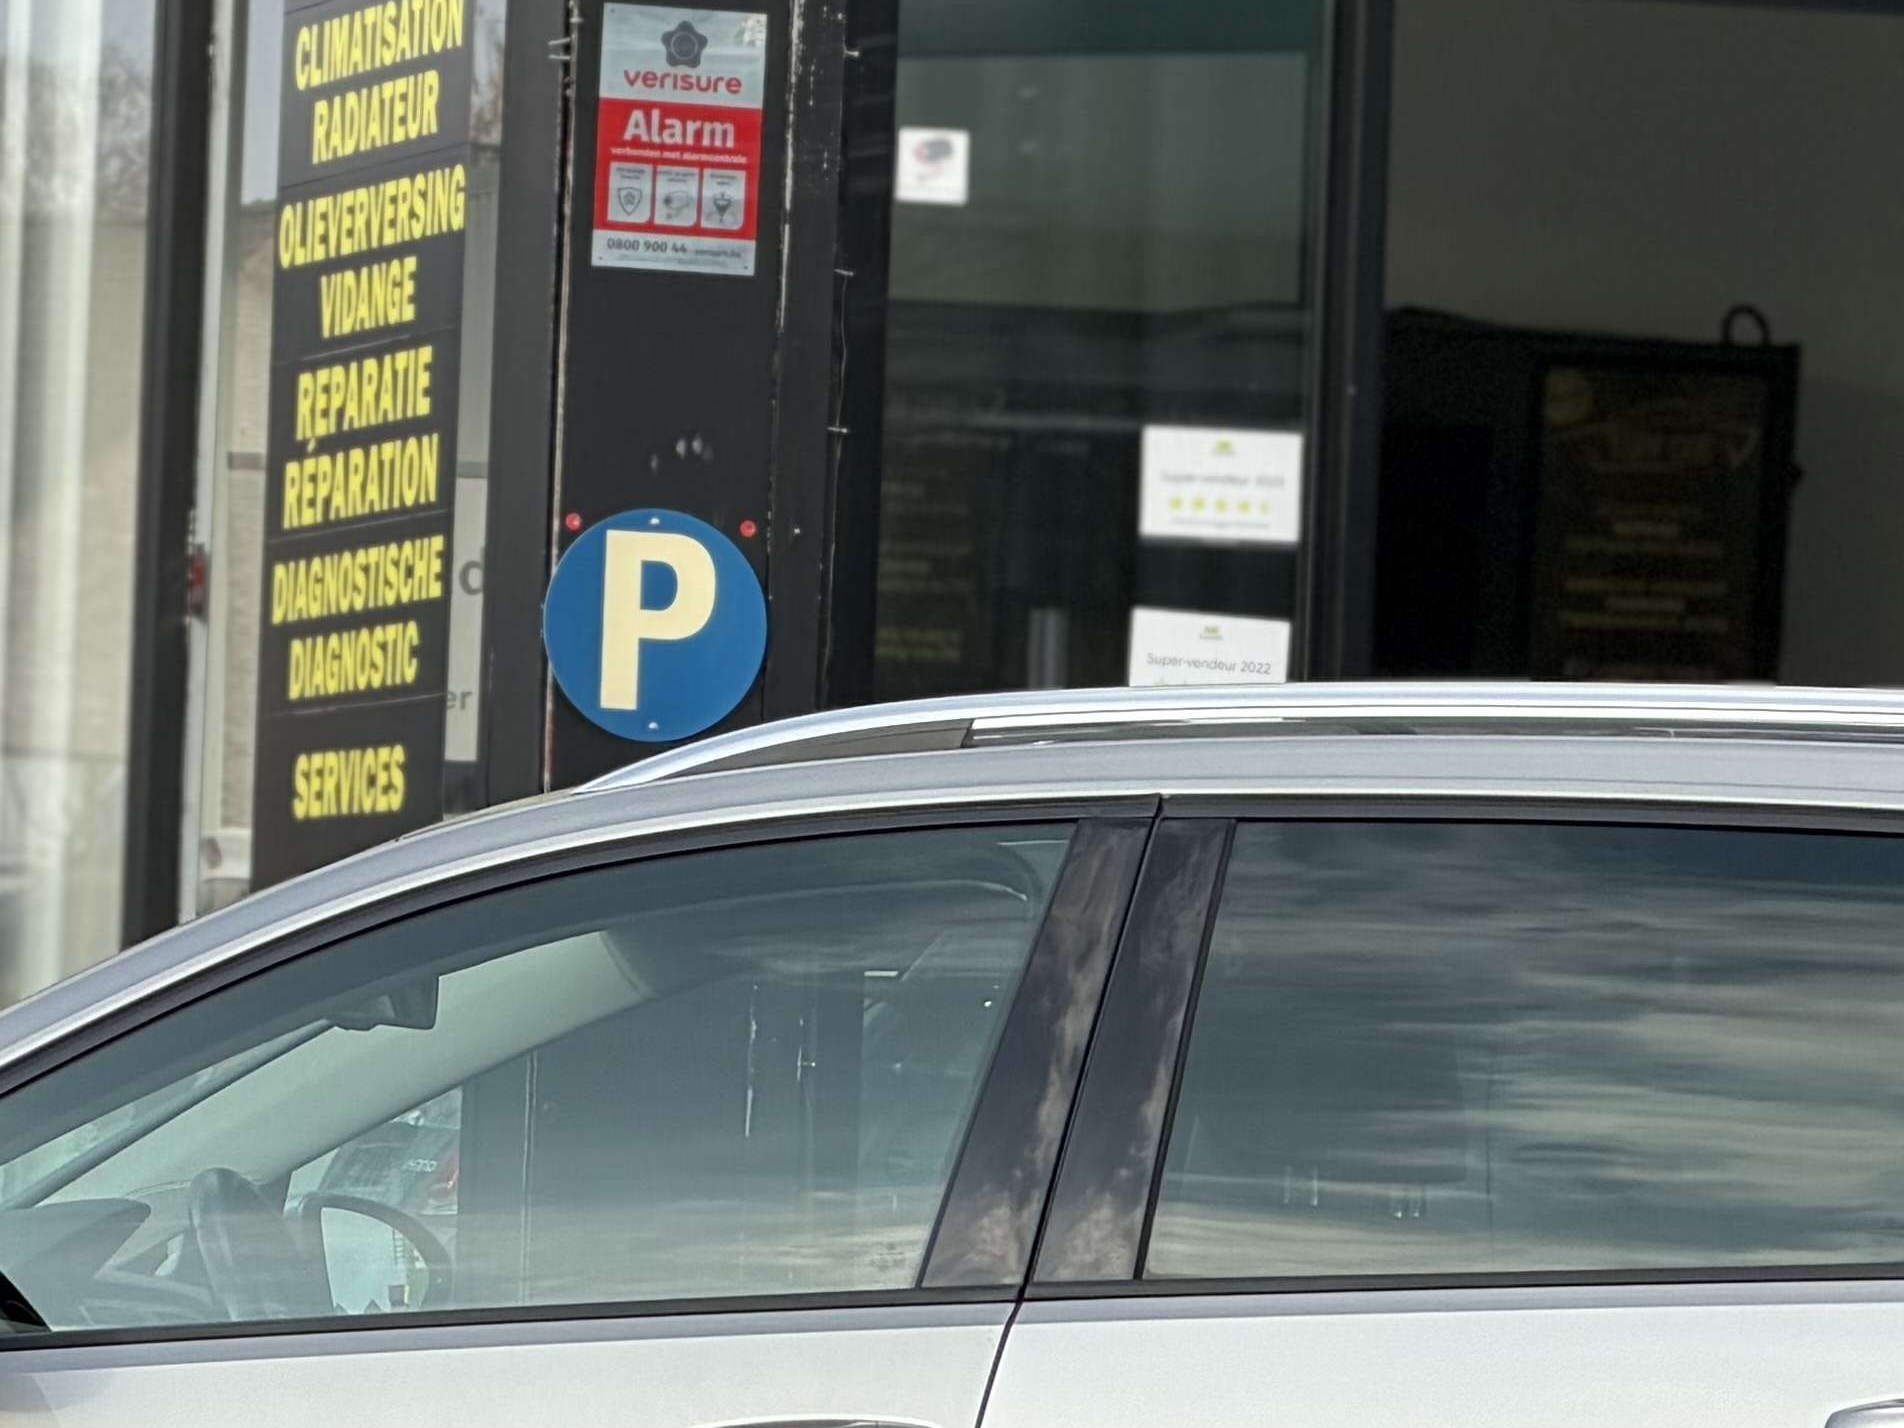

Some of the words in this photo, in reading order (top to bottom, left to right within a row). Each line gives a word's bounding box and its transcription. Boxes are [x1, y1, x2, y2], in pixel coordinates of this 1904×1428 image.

[312, 72, 439, 165] RADIATEUR
[623, 69, 743, 95] verisure
[623, 107, 736, 149] Alarm
[279, 164, 466, 269] OLIEVERVERSING
[607, 237, 640, 251] 0800
[644, 240, 668, 253] 900
[671, 243, 688, 254] 44
[321, 256, 416, 339] VIDANGE
[296, 345, 433, 441] REPARATIE
[283, 430, 438, 530] RÉPARATION
[272, 534, 443, 625] DIAGNOSTISCHE
[600, 530, 716, 710] P
[288, 620, 419, 701] DIAGNOSTIC
[1240, 660, 1272, 675] 2022
[293, 744, 404, 821] SERVICES
